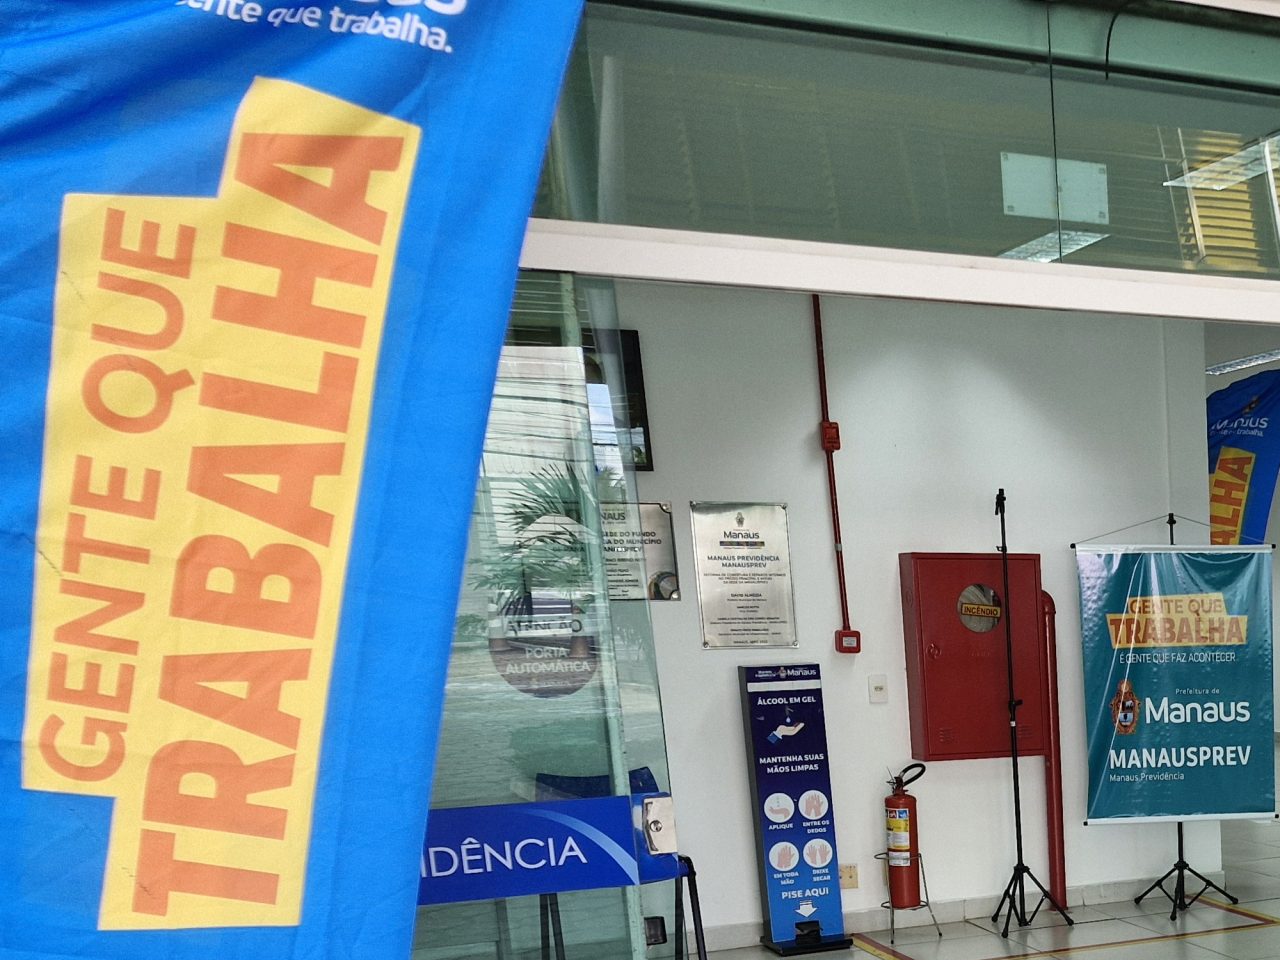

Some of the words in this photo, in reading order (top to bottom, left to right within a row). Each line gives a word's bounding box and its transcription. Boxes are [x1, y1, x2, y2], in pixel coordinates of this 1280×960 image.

[267, 6, 322, 29] que
[329, 6, 453, 53] trabalha.
[82, 208, 196, 434] QUE
[132, 132, 404, 917] TRABALHA
[723, 531, 760, 539] Manaus
[964, 605, 999, 616] INCÊNDIO
[1130, 599, 1183, 615] GENTE
[1186, 597, 1223, 617] QUE
[38, 455, 162, 782] GENTE
[1109, 616, 1244, 645] TRABALHA
[525, 648, 569, 659] PORTA
[1119, 652, 1125, 664] É
[1126, 653, 1151, 664] GENTE
[1152, 653, 1170, 664] QUE
[1171, 653, 1186, 663] FAZ
[1188, 651, 1236, 663] ACONTECER
[506, 660, 591, 675] AUTOMÁTICA
[787, 668, 817, 676] Manaus
[757, 697, 788, 705] ÁLCOOL
[1145, 696, 1250, 724] Manaus
[760, 754, 802, 764] MANTENHA
[804, 753, 824, 761] SUAS
[1109, 746, 1251, 769] MANAUSPREV
[767, 764, 790, 773] MÃOS
[791, 763, 819, 772] LIMPAS
[1109, 773, 1138, 782] Manaus
[1140, 771, 1185, 782] Previdência
[768, 822, 793, 830] APLIQUE
[781, 889, 803, 899] PISE
[805, 887, 829, 898] AQUI
